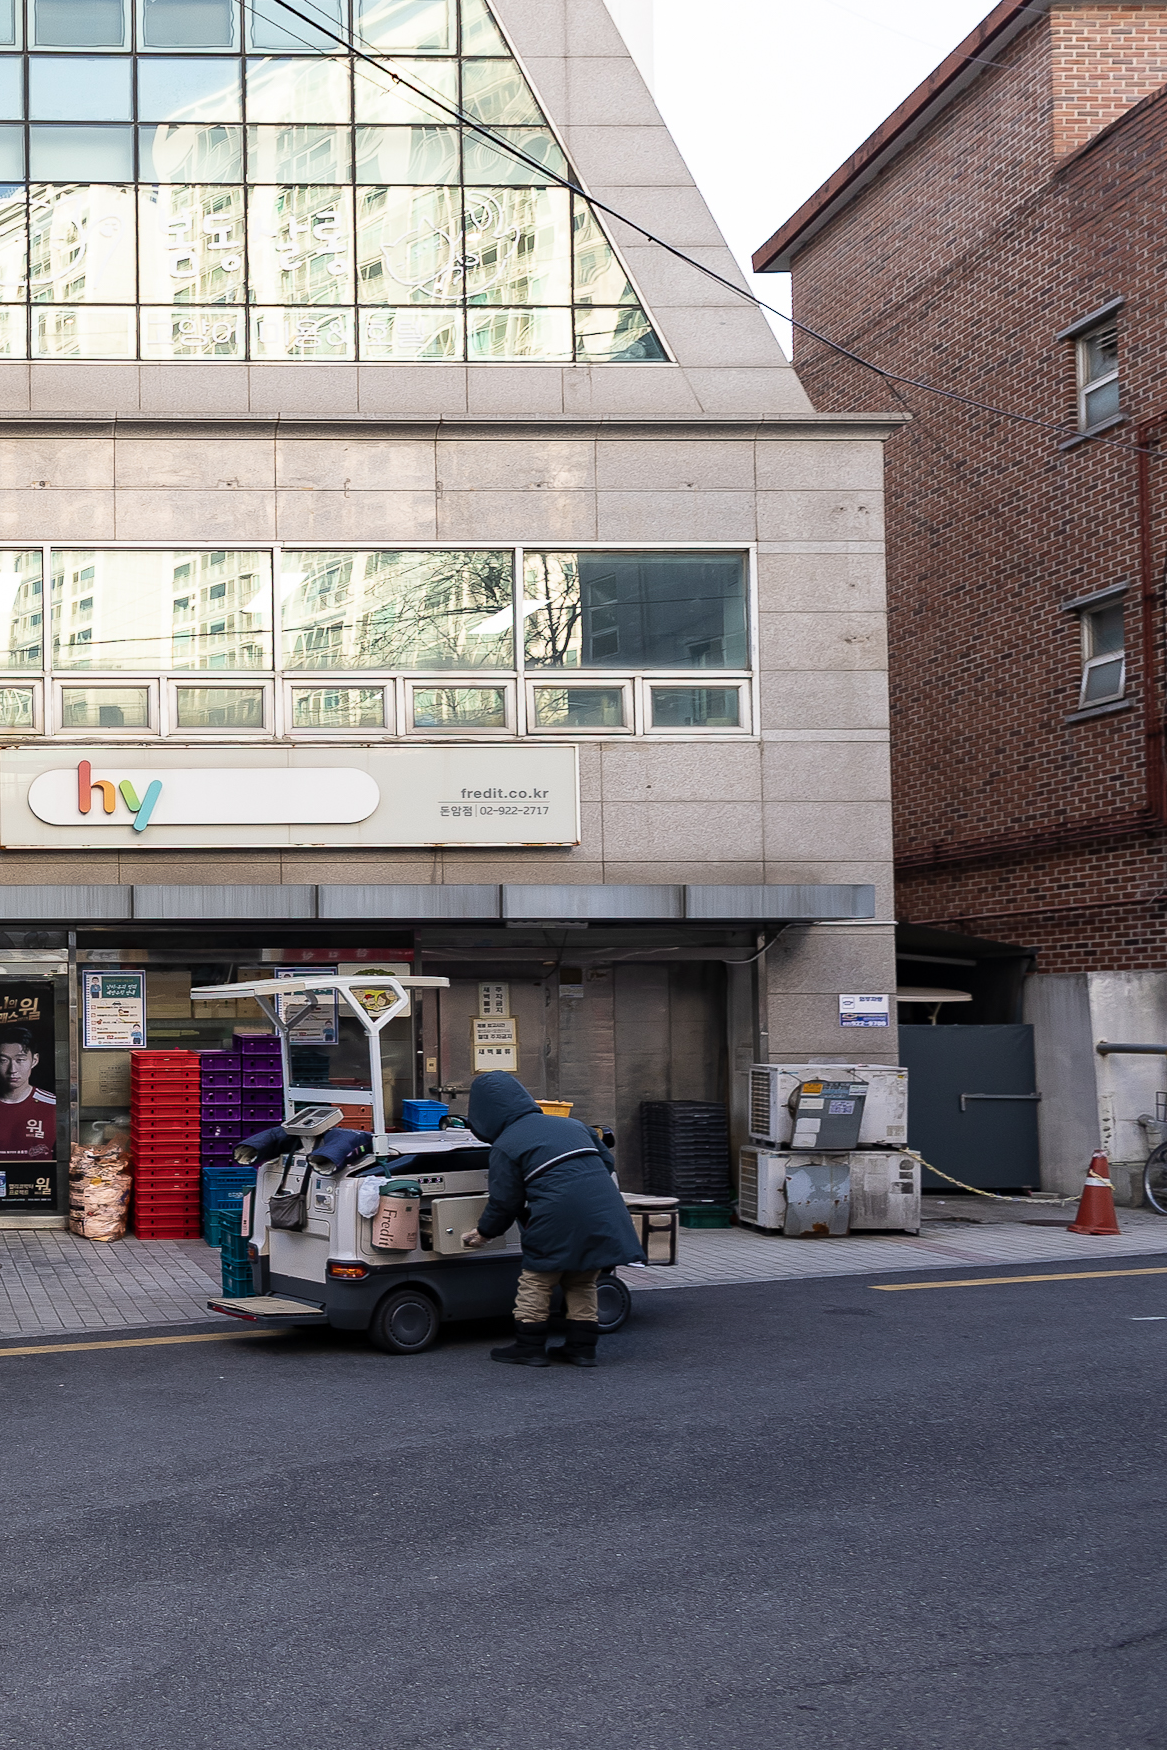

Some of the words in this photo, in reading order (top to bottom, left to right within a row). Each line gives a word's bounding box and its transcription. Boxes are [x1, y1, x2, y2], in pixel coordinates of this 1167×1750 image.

[78, 760, 163, 832] hy
[461, 788, 549, 799] fredit.co.kr
[439, 805, 473, 817] 돈암점
[479, 806, 549, 816] 02-922-2717
[379, 1208, 397, 1246] Fredit
